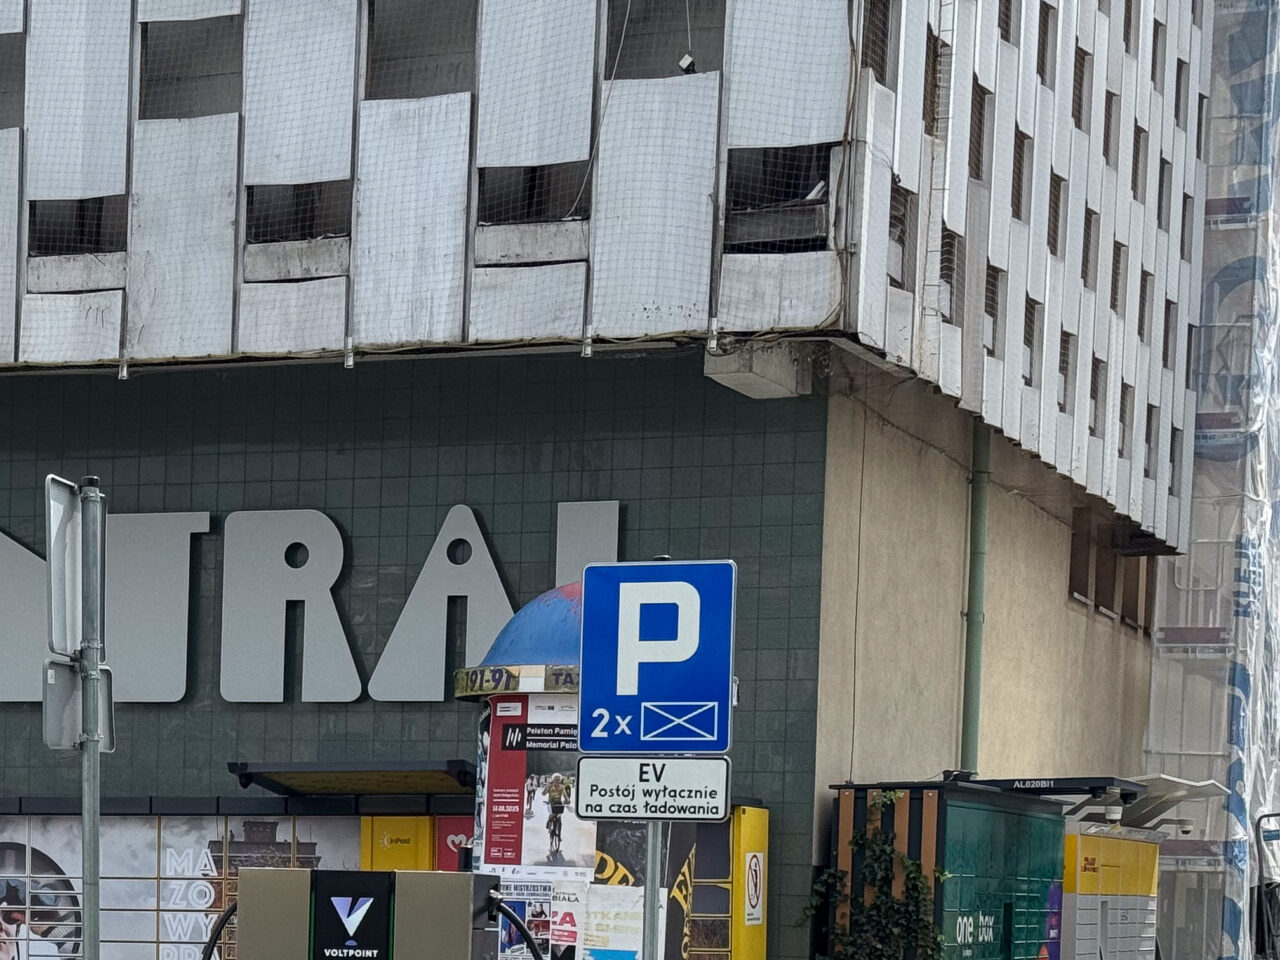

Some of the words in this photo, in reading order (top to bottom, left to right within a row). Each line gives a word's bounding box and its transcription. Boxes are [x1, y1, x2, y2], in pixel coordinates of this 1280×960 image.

[616, 581, 701, 696] P
[526, 727, 553, 735] Peleton
[591, 707, 610, 738] 2
[615, 715, 633, 735] x
[525, 741, 559, 749] Memorial
[639, 763, 666, 783] EV
[590, 784, 636, 801] Postój
[642, 785, 718, 804] wyłącznie
[585, 803, 603, 814] na
[609, 804, 638, 814] czas
[643, 800, 719, 815] ładowania
[166, 848, 218, 876] MA
[167, 880, 215, 909] ZO
[956, 916, 974, 943] one
[979, 910, 995, 942] box
[324, 948, 379, 958] VOLTPOINT
